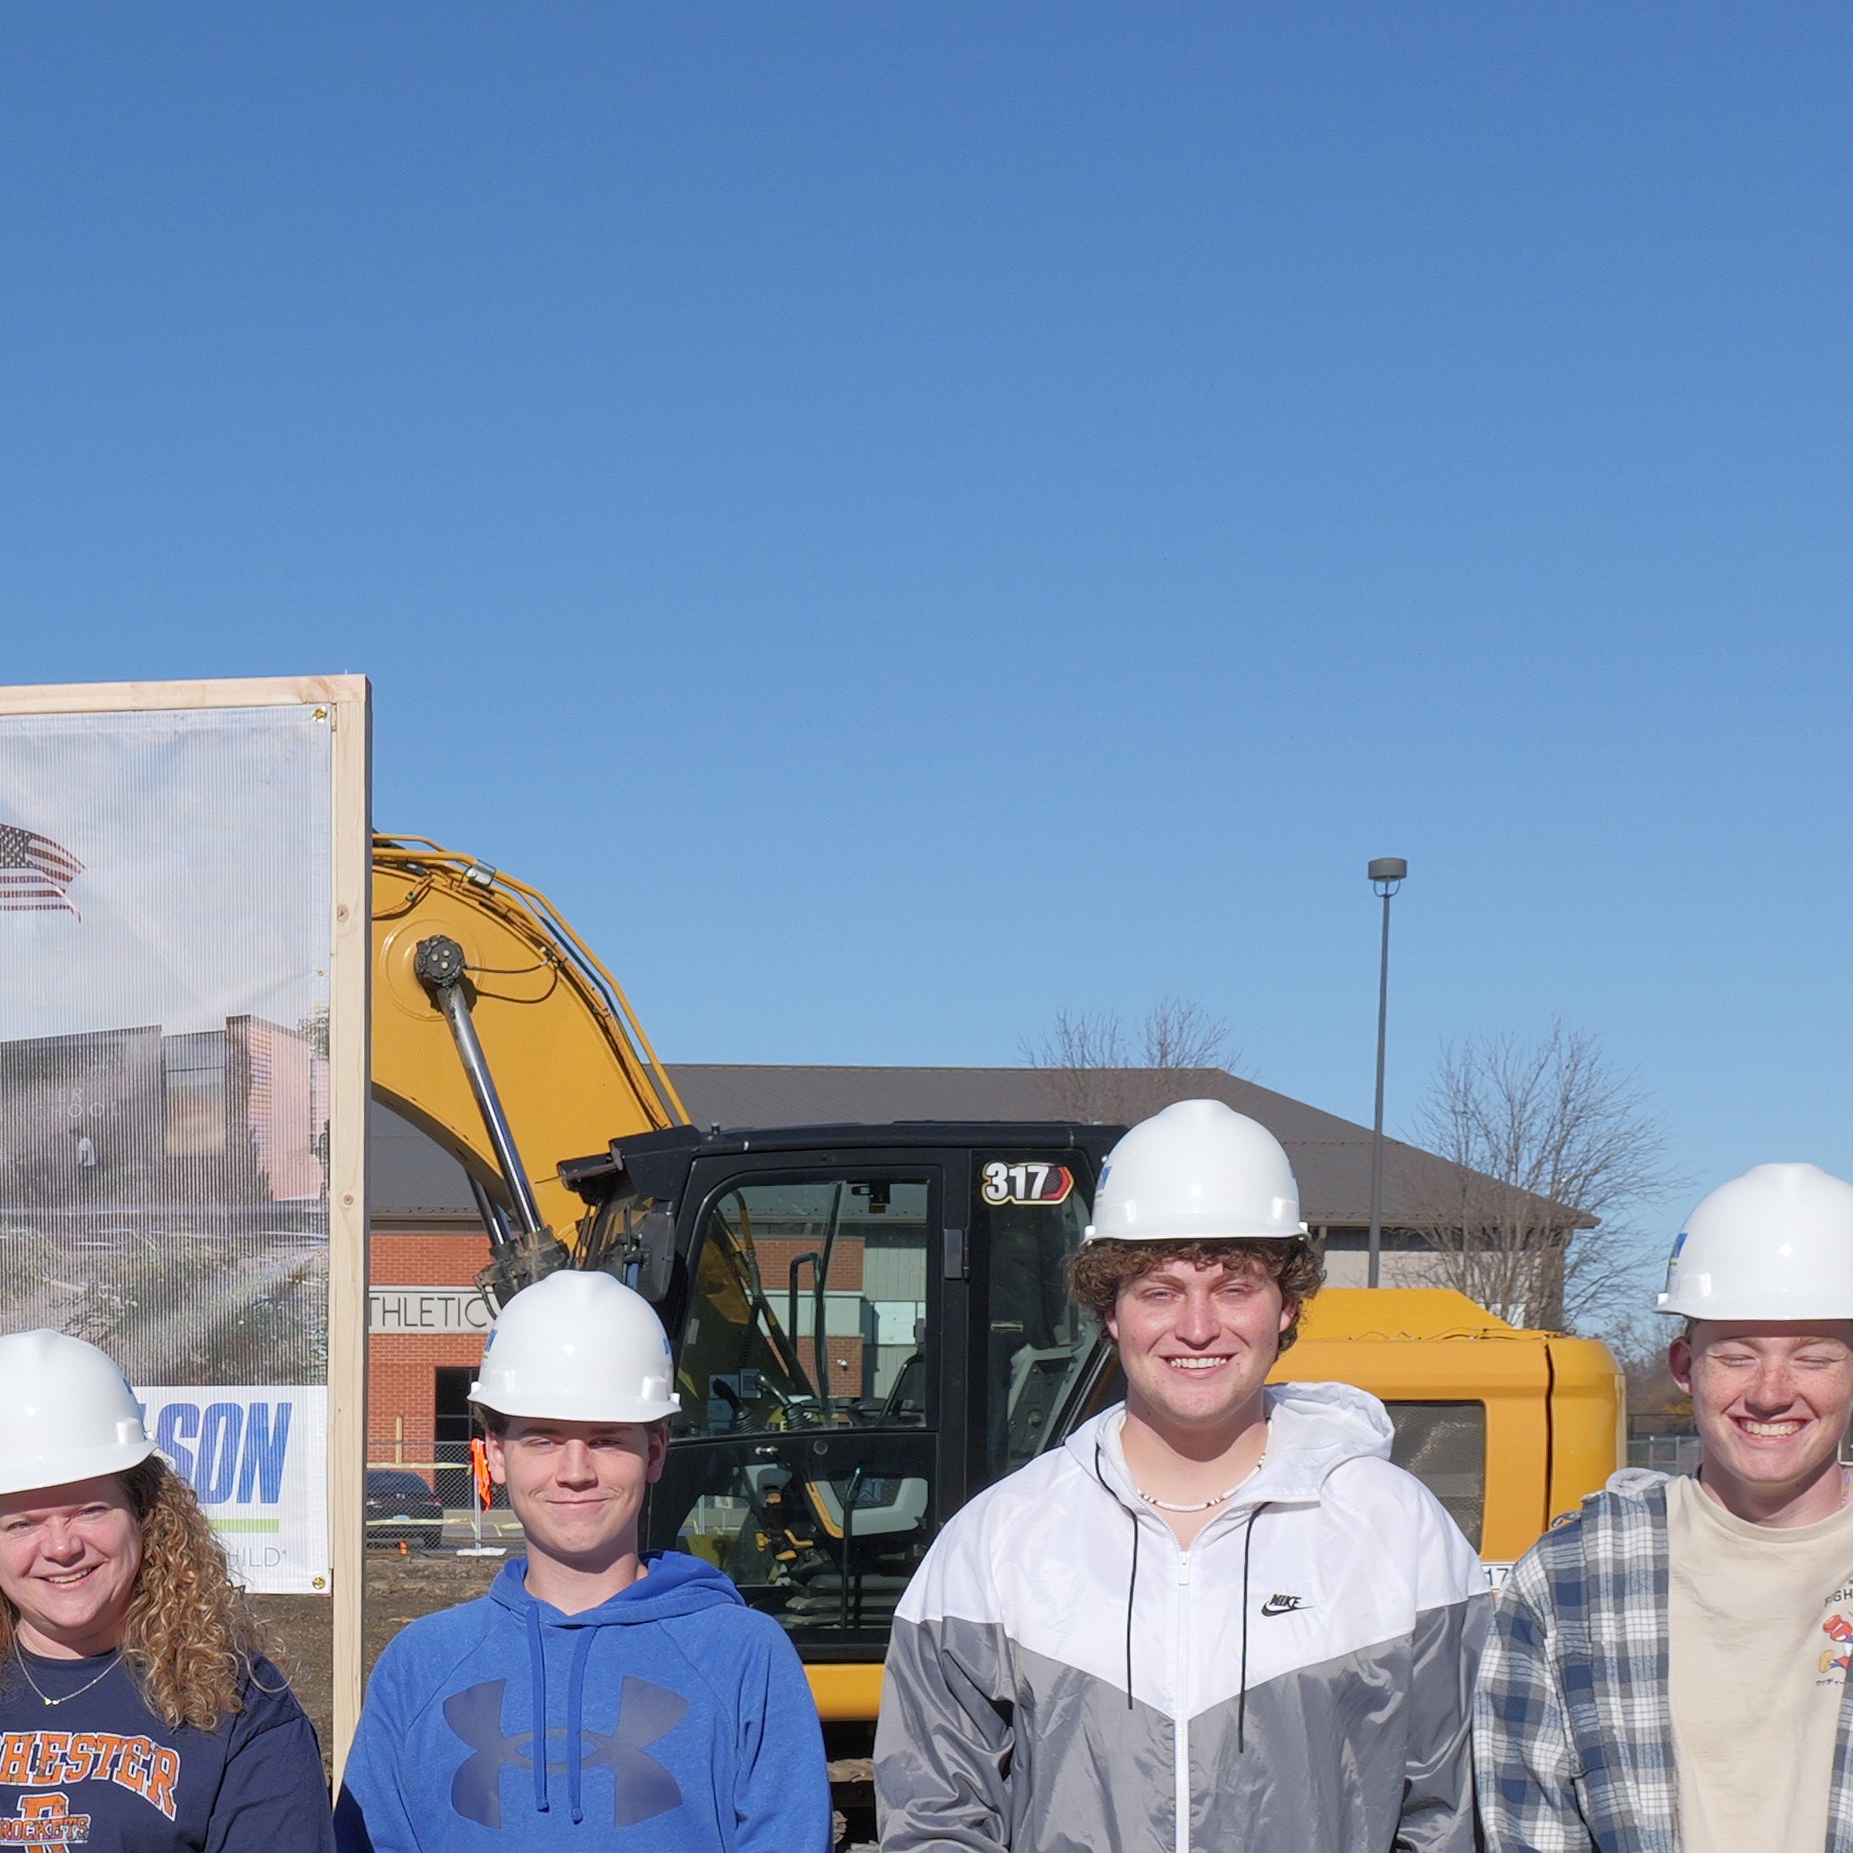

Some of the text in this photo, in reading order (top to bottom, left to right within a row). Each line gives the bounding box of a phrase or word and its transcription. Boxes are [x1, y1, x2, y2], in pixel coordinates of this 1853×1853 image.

[985, 1162, 1050, 1201] 317
[369, 1296, 487, 1328] THLETIC
[138, 1402, 293, 1504] SON
[227, 1546, 281, 1568] UILD
